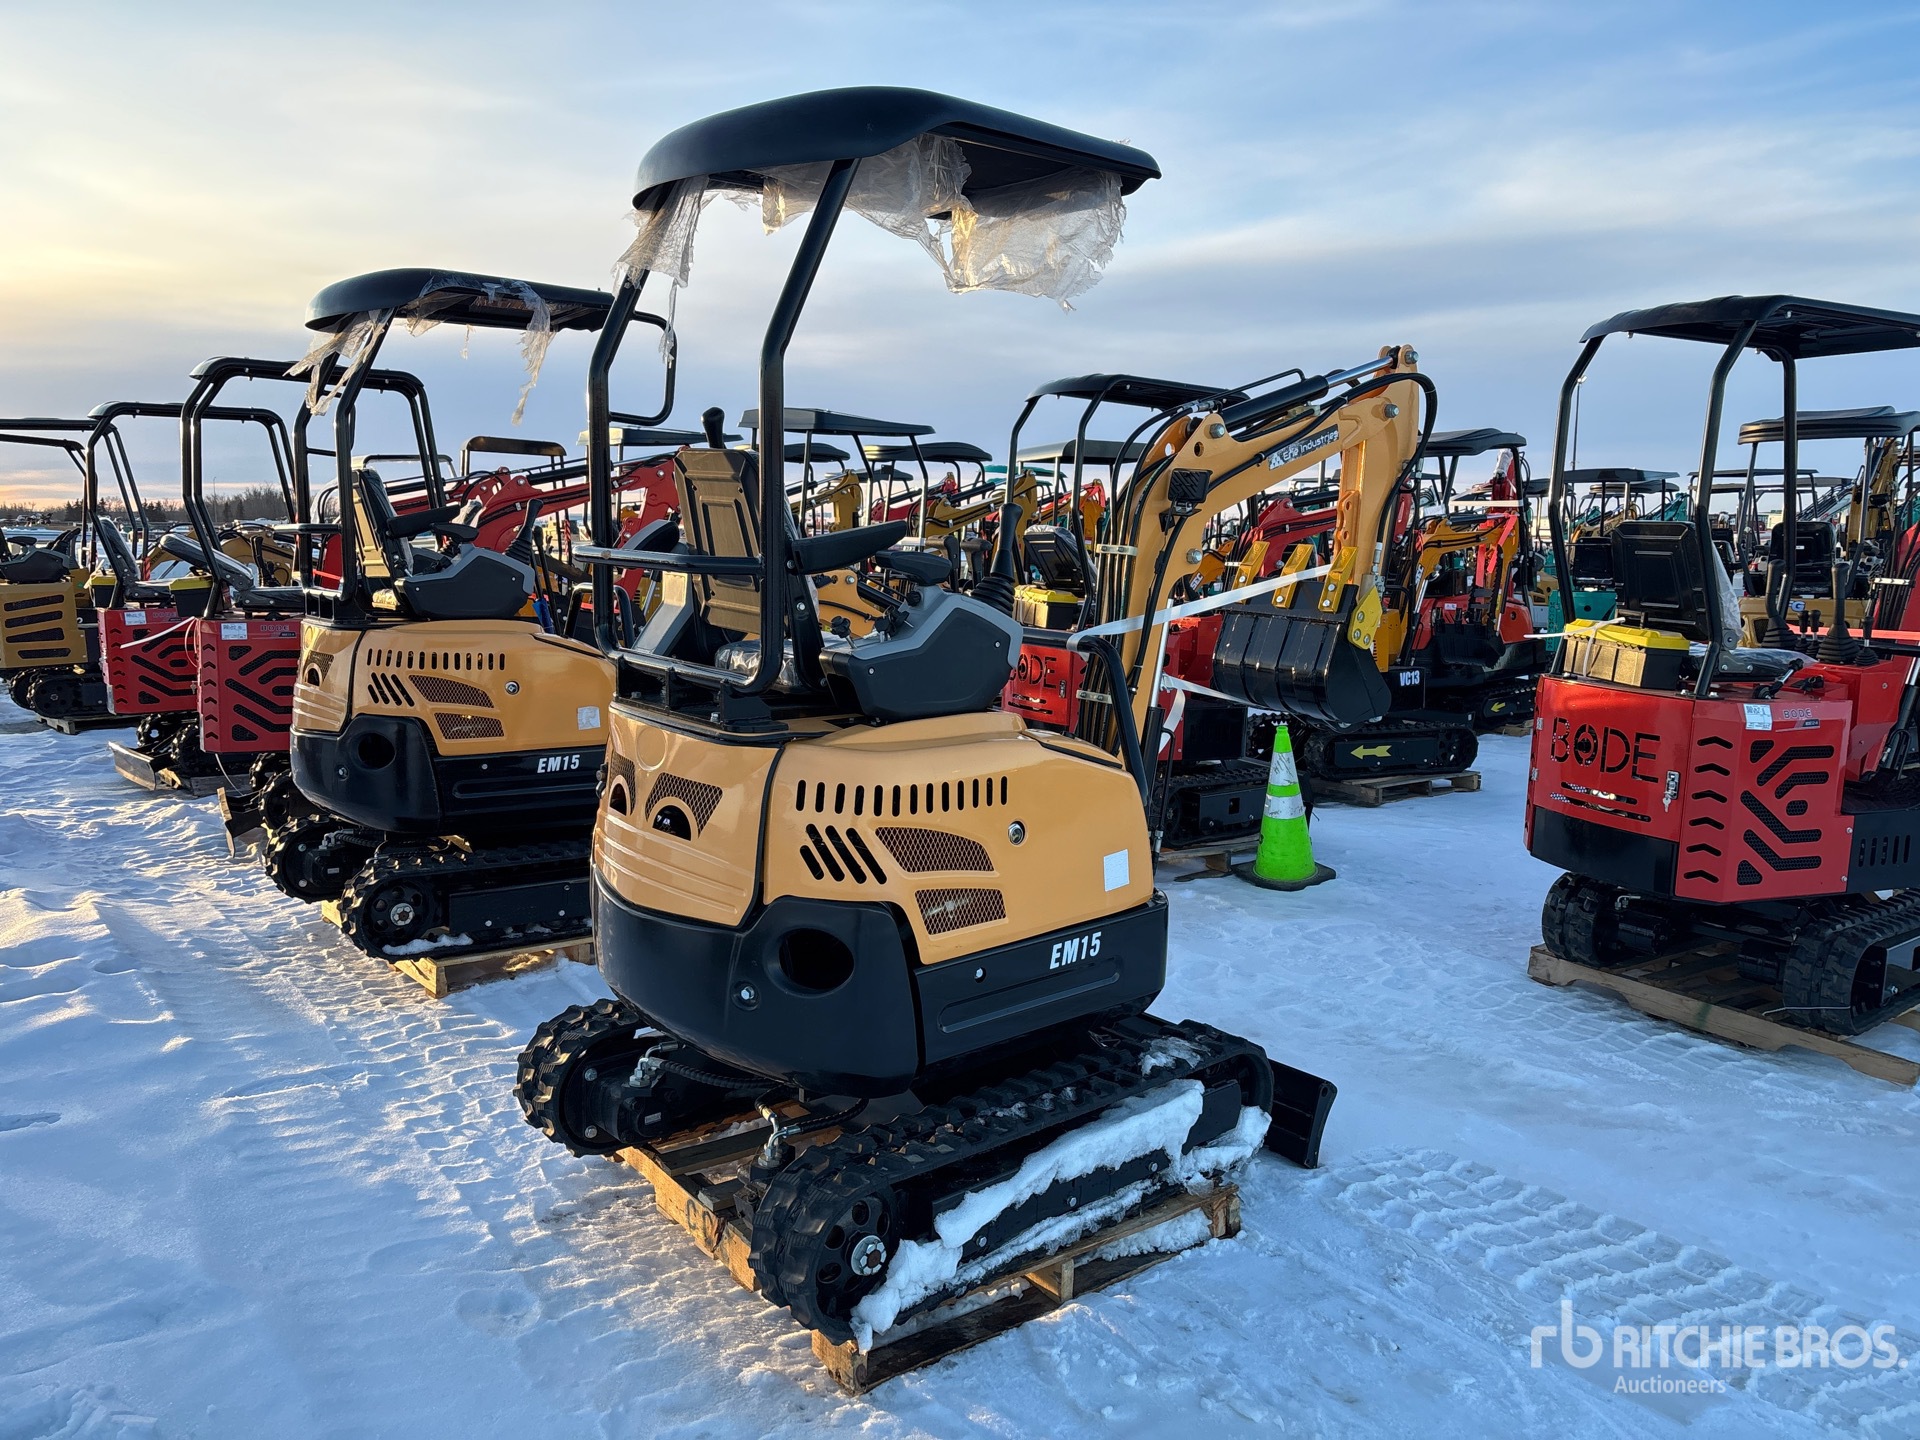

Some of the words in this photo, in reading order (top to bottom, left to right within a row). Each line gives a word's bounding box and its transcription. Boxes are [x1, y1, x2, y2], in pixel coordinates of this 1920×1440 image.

[1010, 653, 1057, 689] ODE
[1399, 670, 1420, 687] VC13
[1783, 708, 1813, 719] BODE
[537, 753, 580, 774] EM15
[1551, 716, 1661, 784] BODE
[1049, 930, 1102, 970] EM15
